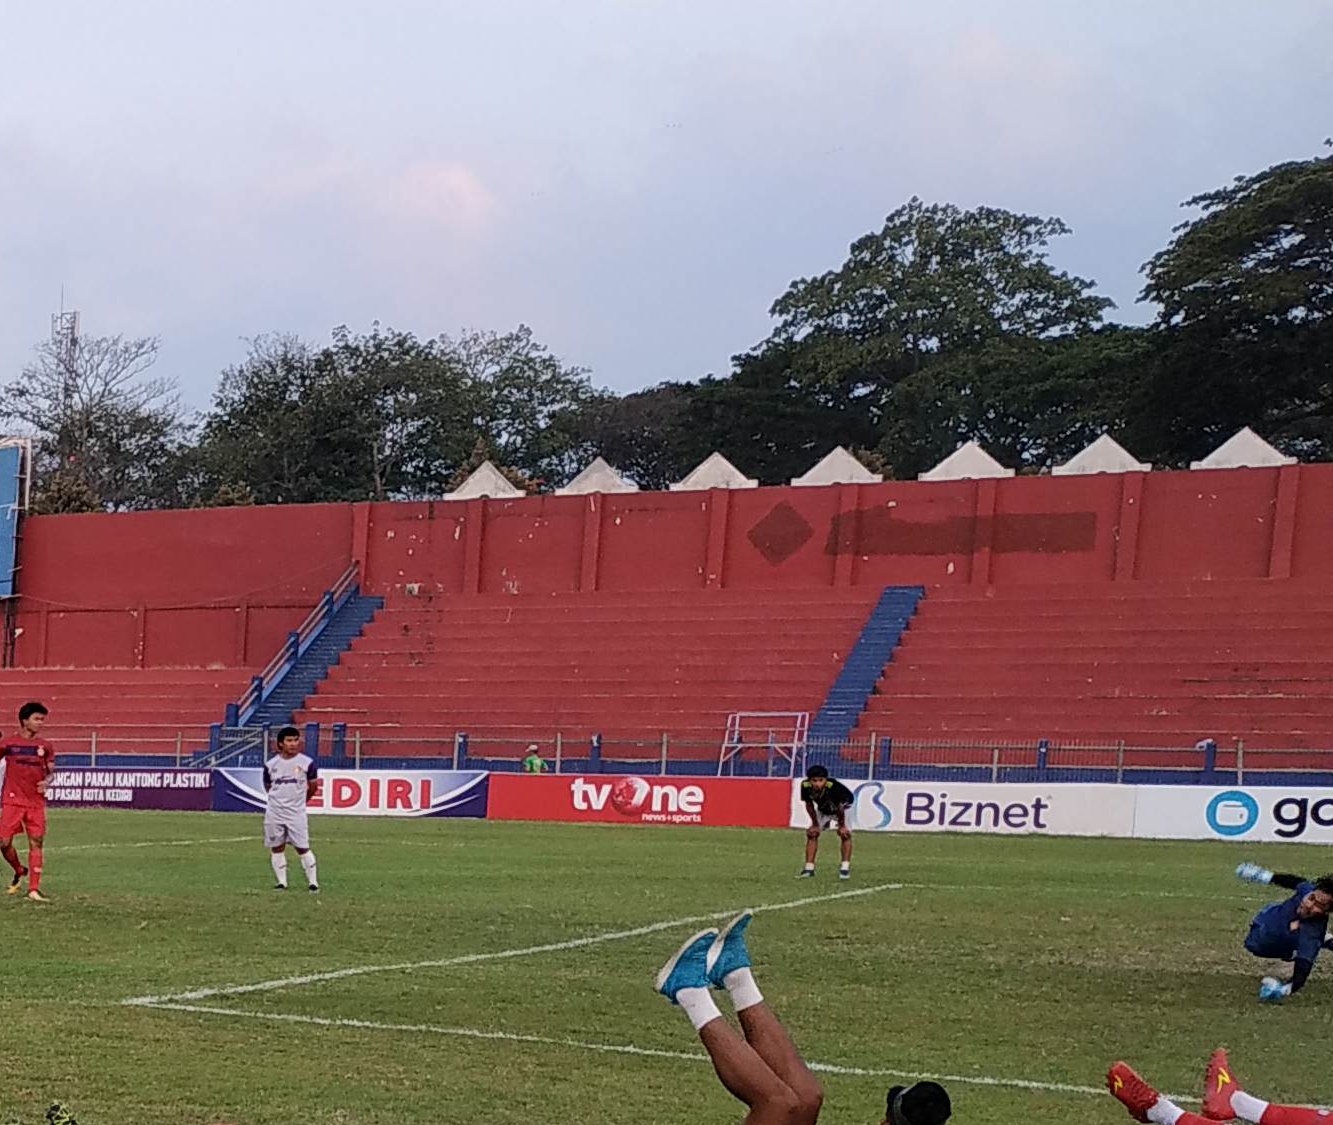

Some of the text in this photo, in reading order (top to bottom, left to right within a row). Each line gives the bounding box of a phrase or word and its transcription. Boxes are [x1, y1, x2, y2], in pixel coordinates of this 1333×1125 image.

[85, 772, 113, 787] PAKAI
[115, 773, 160, 788] KANTONG
[162, 773, 210, 788] PLASTIK!
[55, 789, 81, 801] PASAR
[83, 789, 104, 801] KOTA
[905, 791, 1049, 829] Biznet
